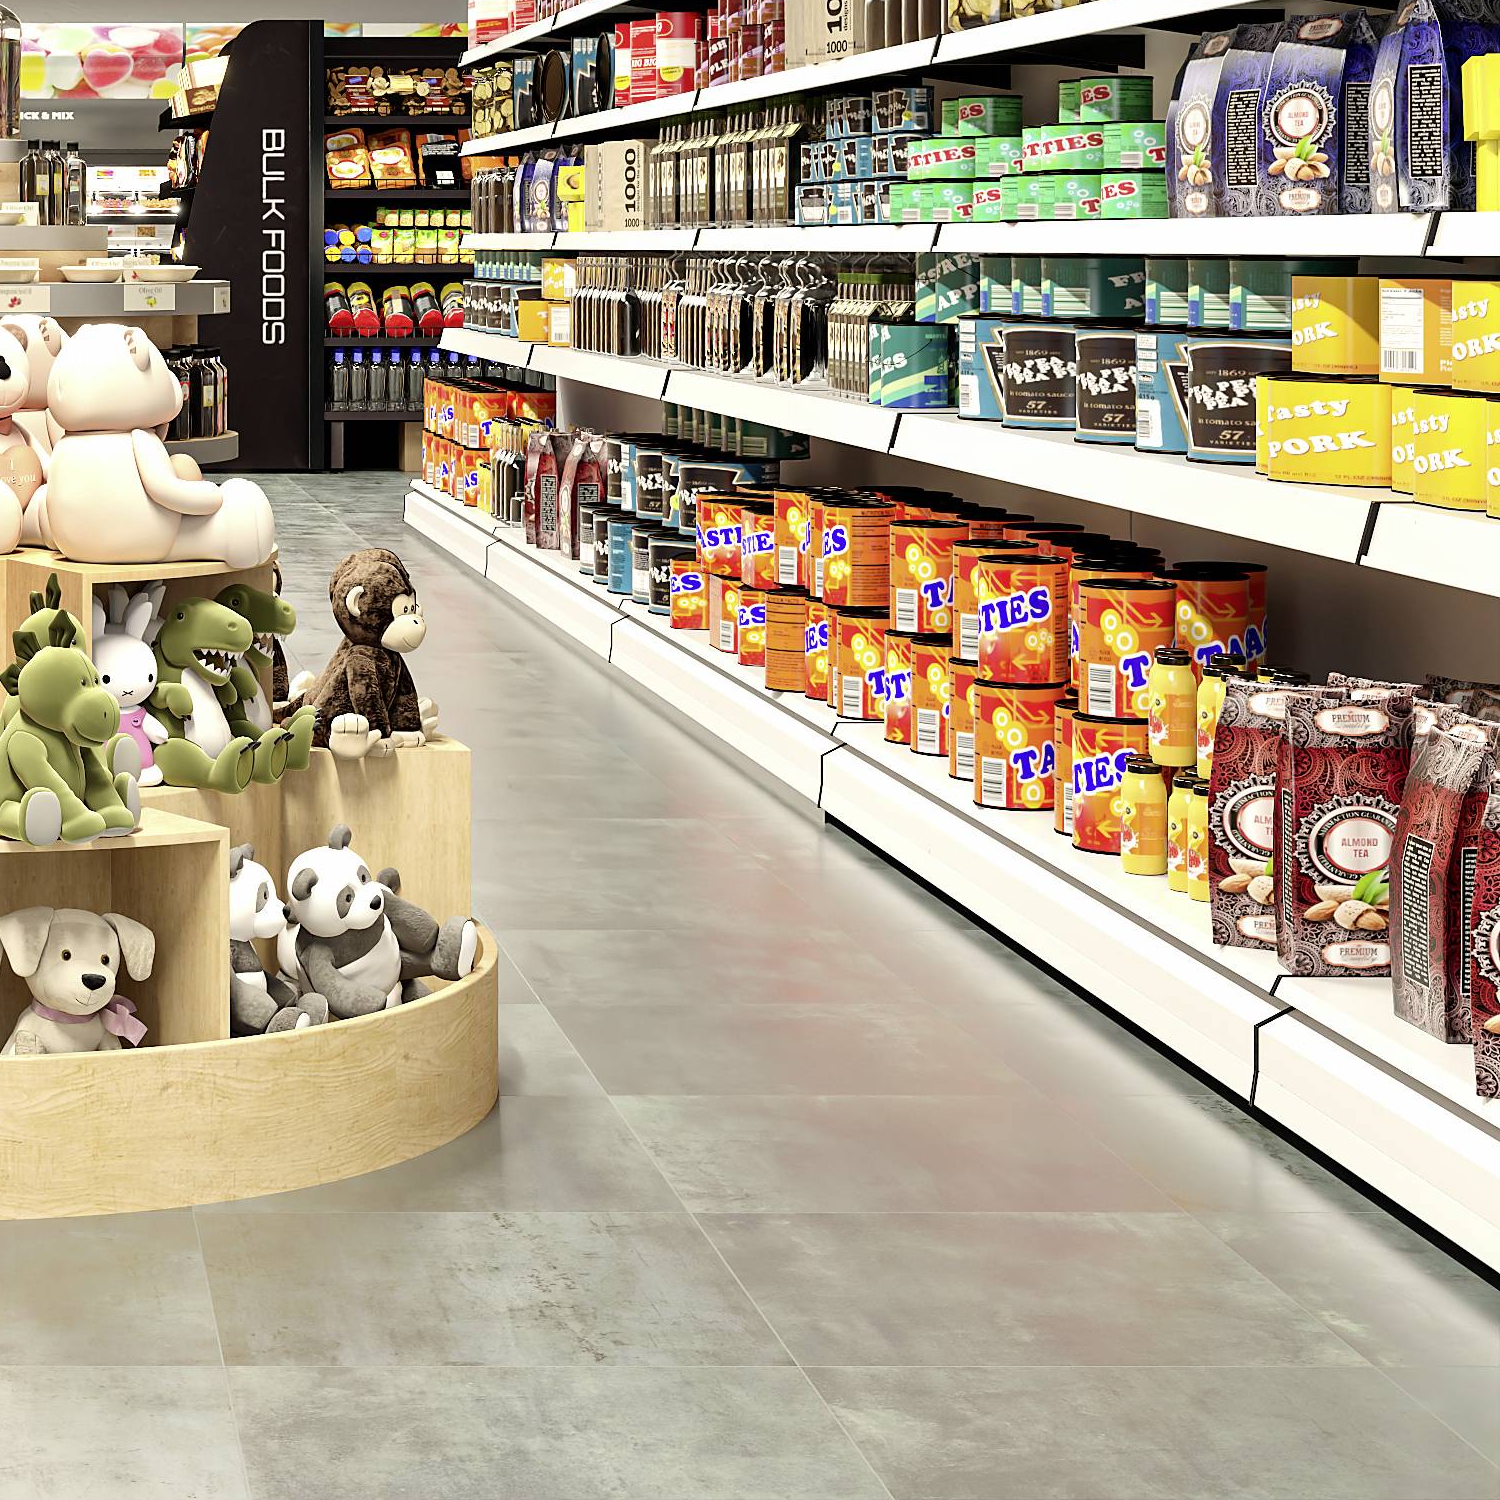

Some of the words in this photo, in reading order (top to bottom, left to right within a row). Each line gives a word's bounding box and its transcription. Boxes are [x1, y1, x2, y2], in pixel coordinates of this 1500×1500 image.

[826, 40, 848, 53] 1000
[20, 112, 40, 120] ICK
[41, 112, 50, 120] &
[52, 112, 74, 120] MIX
[262, 128, 285, 221] BULK
[625, 148, 636, 213] 1000
[625, 218, 640, 228] 1000
[262, 229, 285, 345] FOODS
[1292, 321, 1338, 346] ORK
[1452, 332, 1500, 361] ORK
[1101, 358, 1127, 366] 1869
[1218, 369, 1246, 377] 1869
[1047, 391, 1075, 399] sauce
[1026, 400, 1047, 410] 57
[1090, 402, 1119, 410] tomato
[1102, 413, 1123, 423] 57
[1205, 418, 1241, 426] tomato
[1219, 429, 1245, 440] 57
[1268, 430, 1377, 458] PORK
[1414, 448, 1472, 474] ORK
[978, 590, 1050, 634] TIES
[1332, 713, 1370, 723] PREMIUM
[1341, 838, 1378, 847] ALMOND
[1353, 849, 1369, 858] TEA
[1339, 947, 1378, 956] PREMIUM
